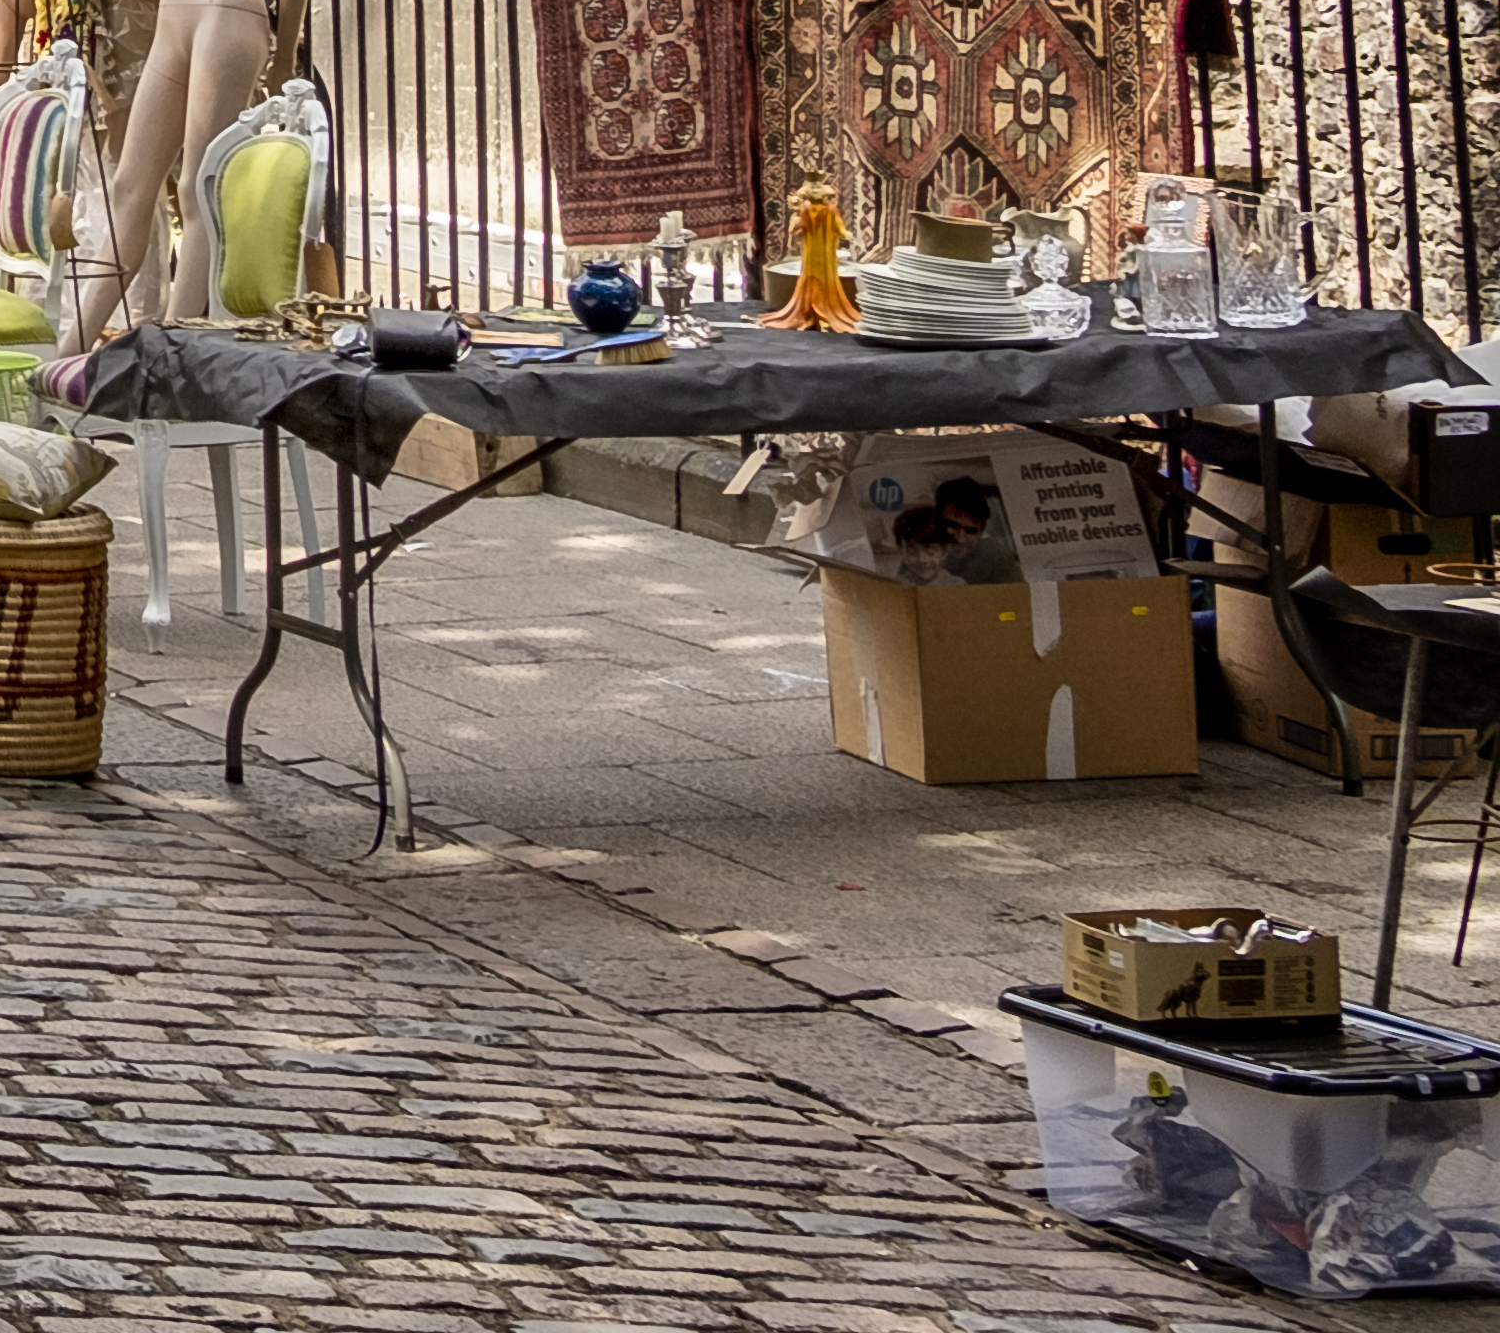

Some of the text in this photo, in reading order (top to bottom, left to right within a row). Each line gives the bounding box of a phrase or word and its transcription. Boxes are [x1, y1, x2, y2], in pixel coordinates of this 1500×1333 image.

[1019, 458, 1109, 482] Affordable
[875, 478, 900, 510] hp
[1035, 482, 1105, 504] printing
[1033, 501, 1117, 524] from your
[1019, 521, 1144, 547] mobile devices
